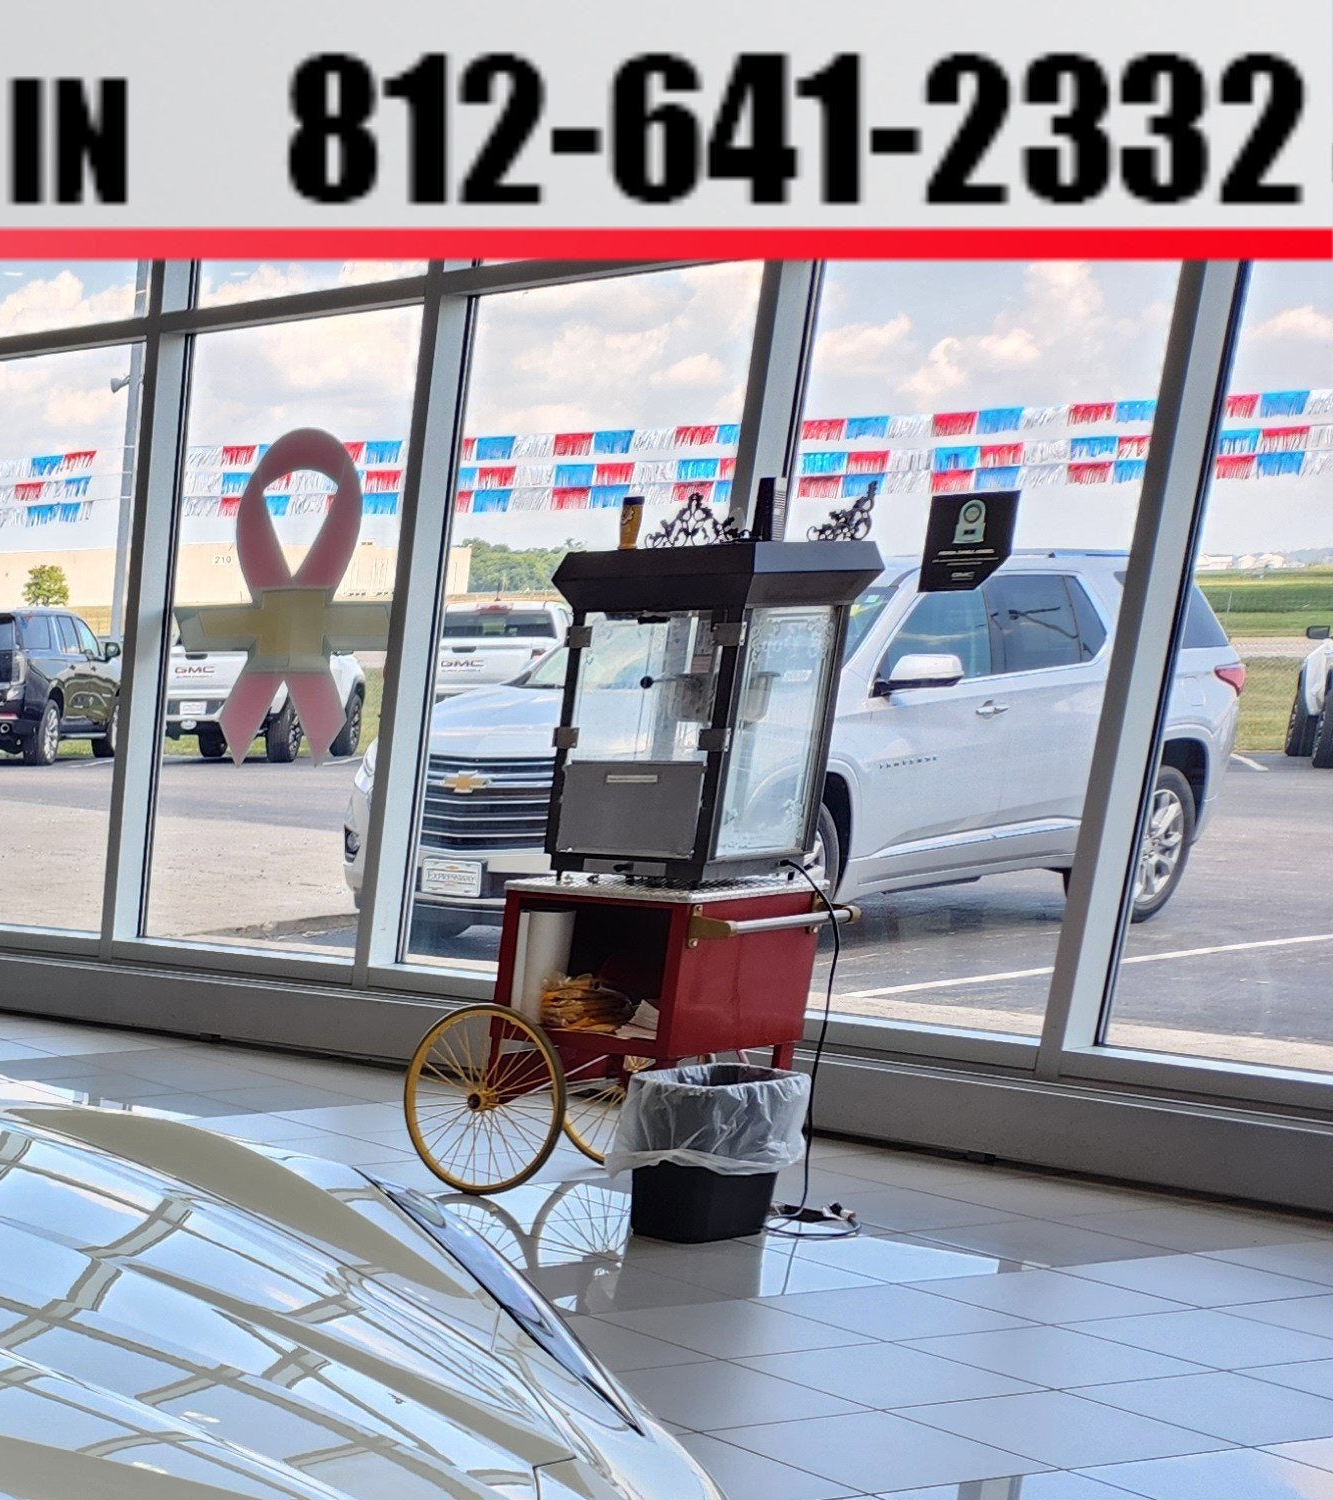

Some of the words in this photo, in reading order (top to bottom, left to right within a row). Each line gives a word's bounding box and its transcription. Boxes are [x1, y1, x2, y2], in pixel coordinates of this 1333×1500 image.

[214, 556, 232, 564] 210
[440, 659, 485, 668] GMC
[174, 666, 215, 674] GMC
